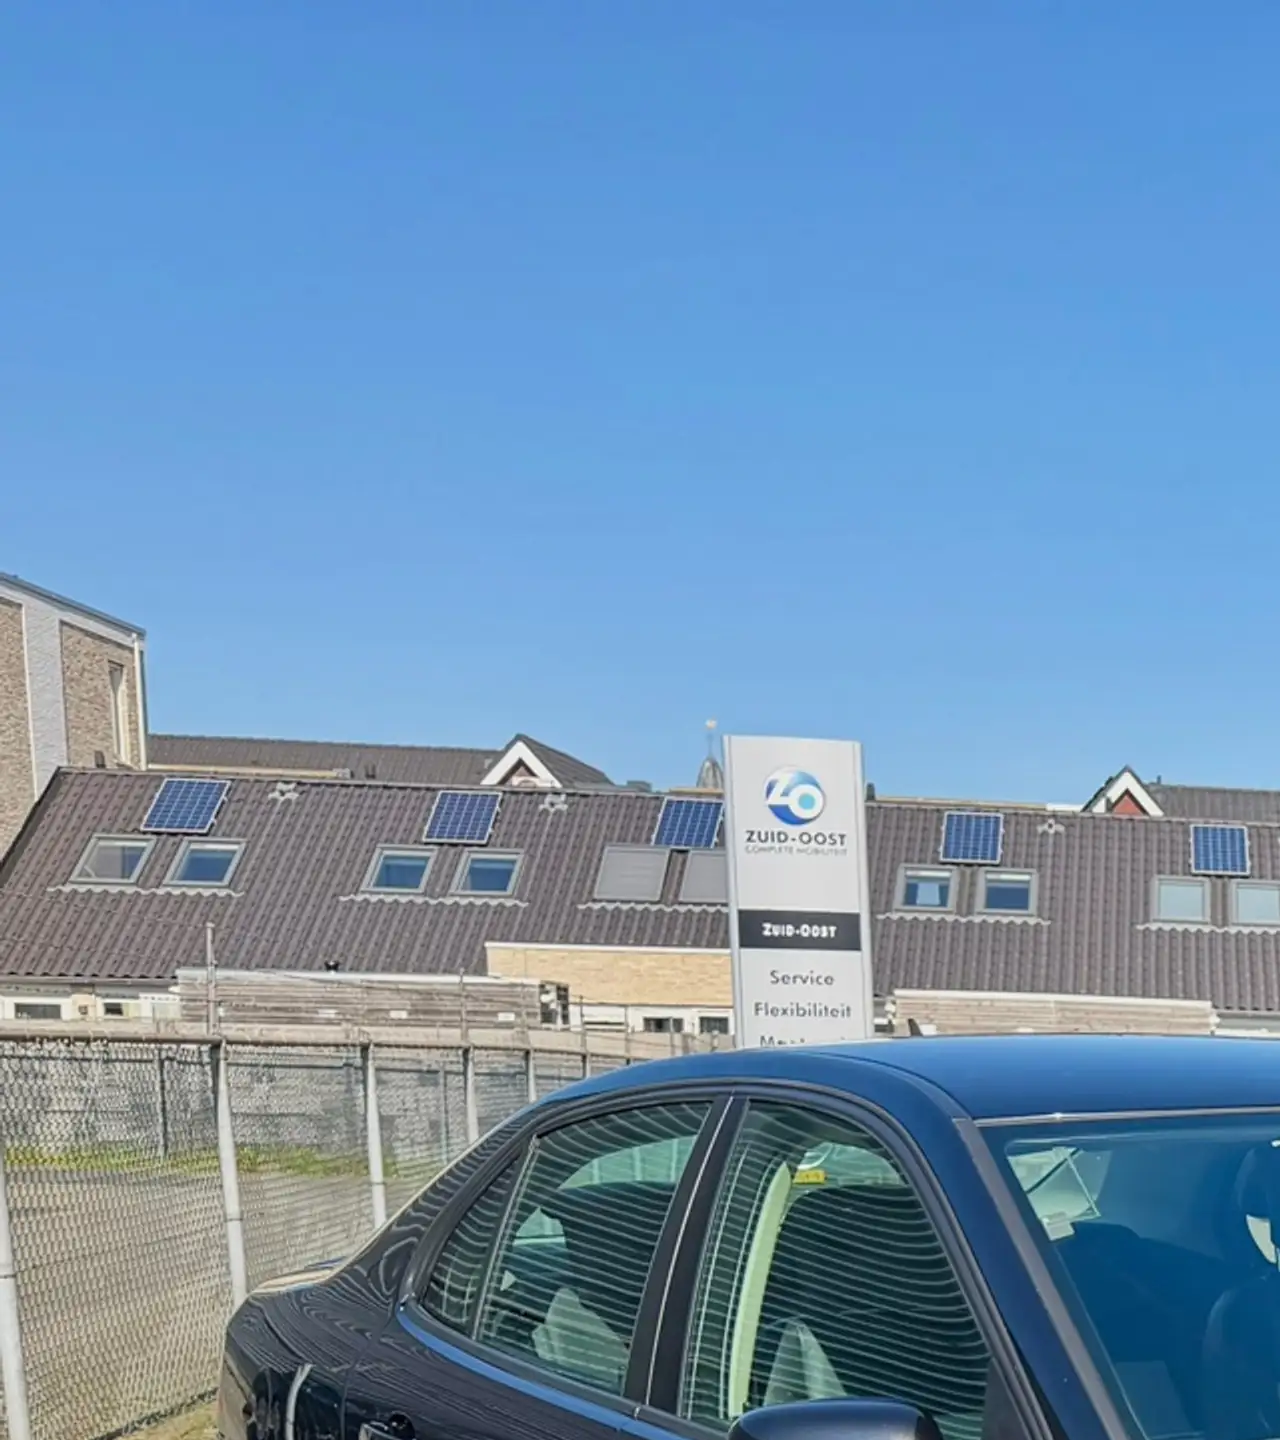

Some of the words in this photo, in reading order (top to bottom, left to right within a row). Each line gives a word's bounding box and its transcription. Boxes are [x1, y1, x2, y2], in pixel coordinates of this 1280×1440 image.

[745, 829, 847, 846] ZUID-OOST
[761, 921, 837, 939] ZUID-OOST
[769, 969, 835, 986] Service
[753, 1001, 852, 1019] Flexibiliteit
